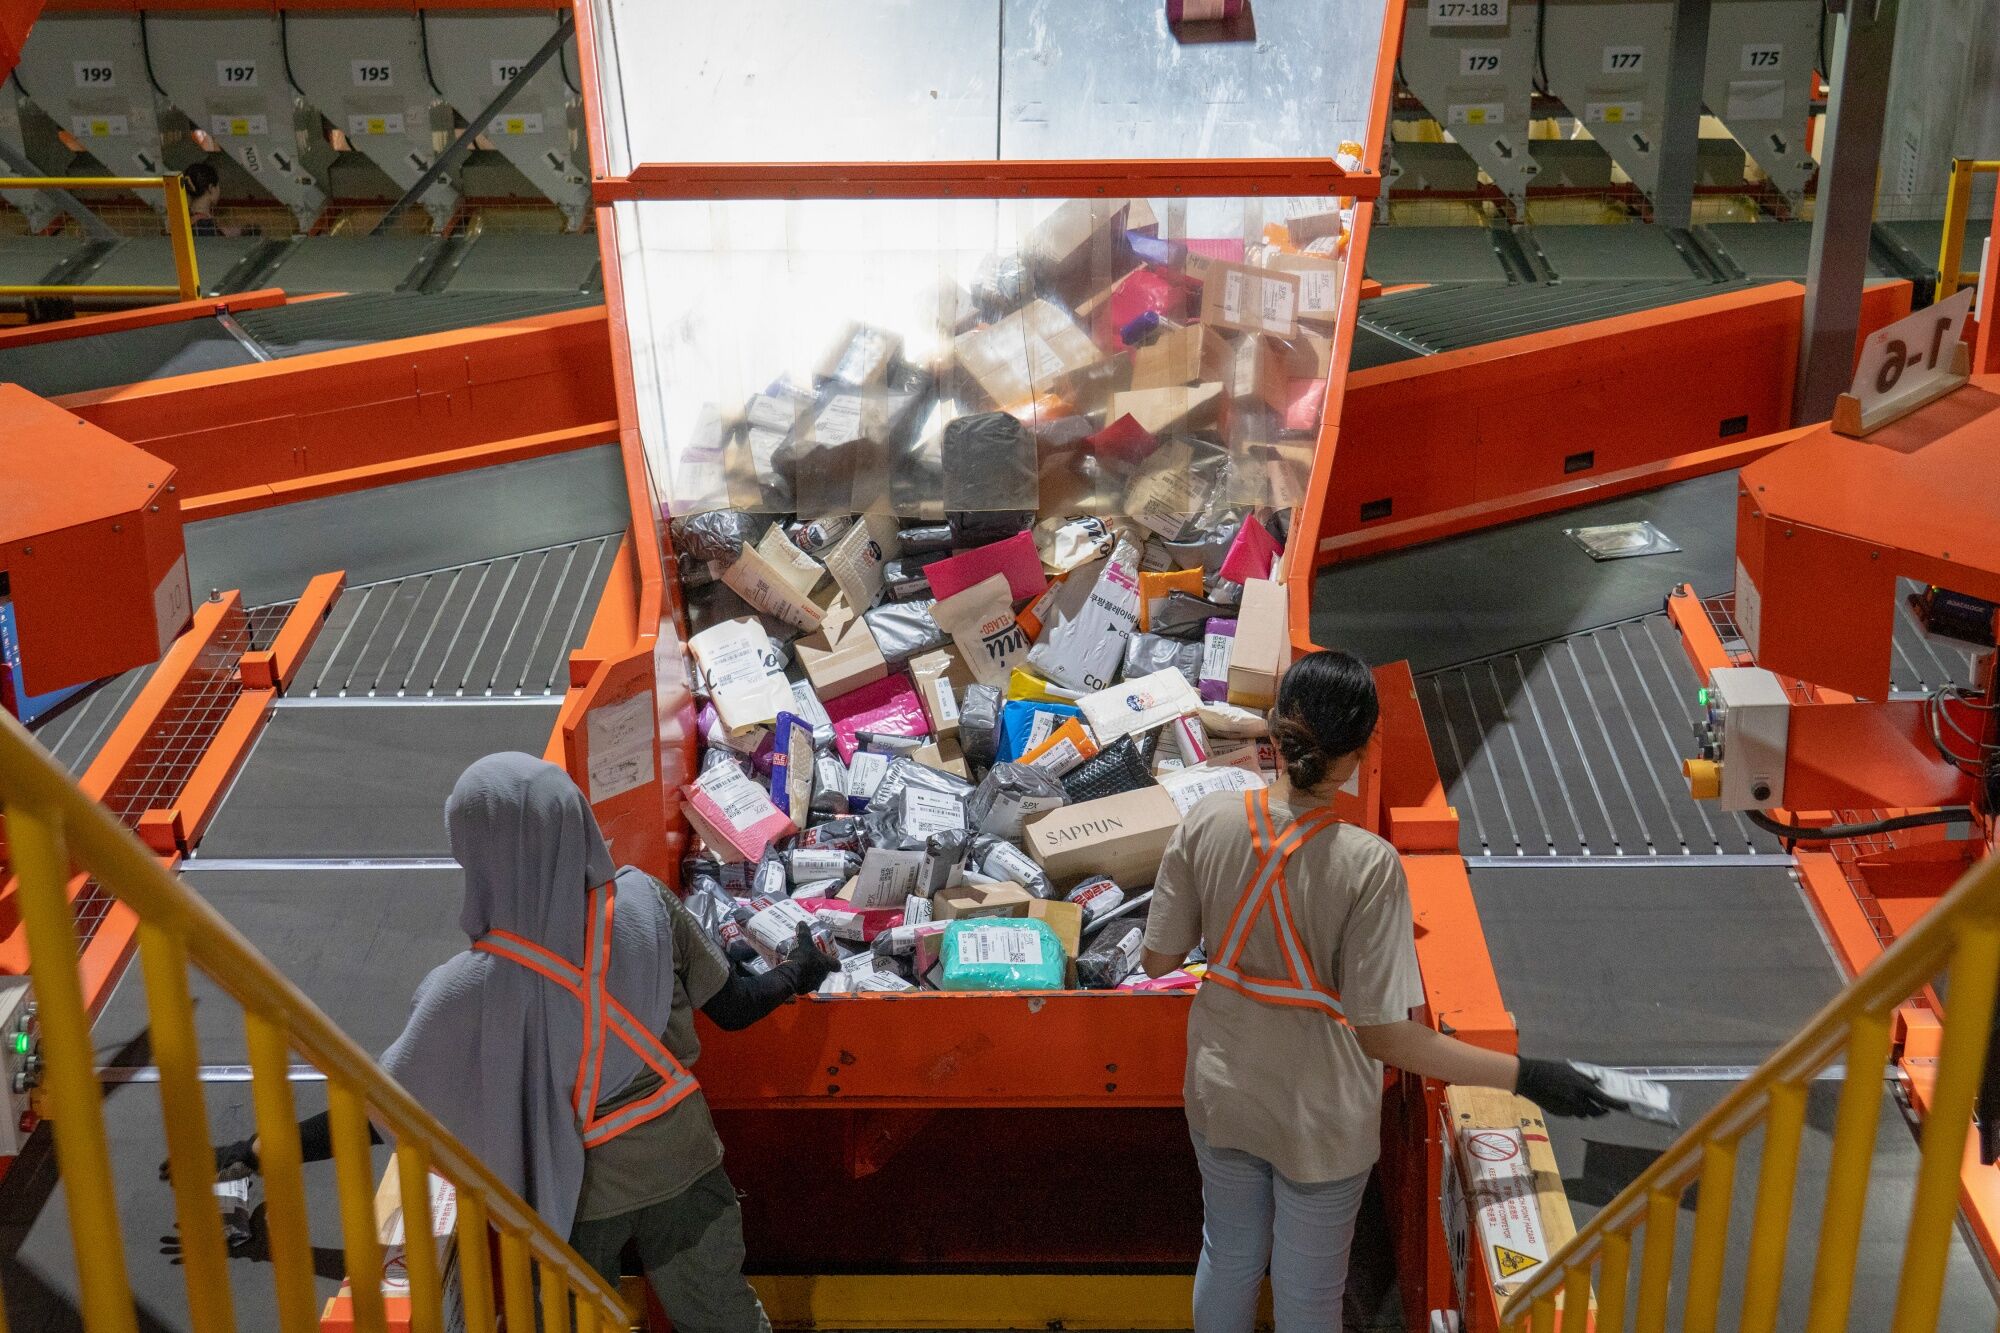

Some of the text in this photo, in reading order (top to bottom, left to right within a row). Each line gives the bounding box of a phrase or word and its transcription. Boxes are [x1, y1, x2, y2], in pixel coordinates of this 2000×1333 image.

[1438, 3, 1499, 16] 177-183
[1468, 56, 1498, 71] 179
[1610, 53, 1641, 68] 177
[1750, 51, 1779, 66] 175
[81, 68, 112, 82] 199
[224, 67, 254, 81] 197
[359, 67, 389, 81] 195
[499, 66, 526, 80] 19
[1020, 801, 1039, 810] SPX
[1045, 816, 1123, 845] SAPPUN
